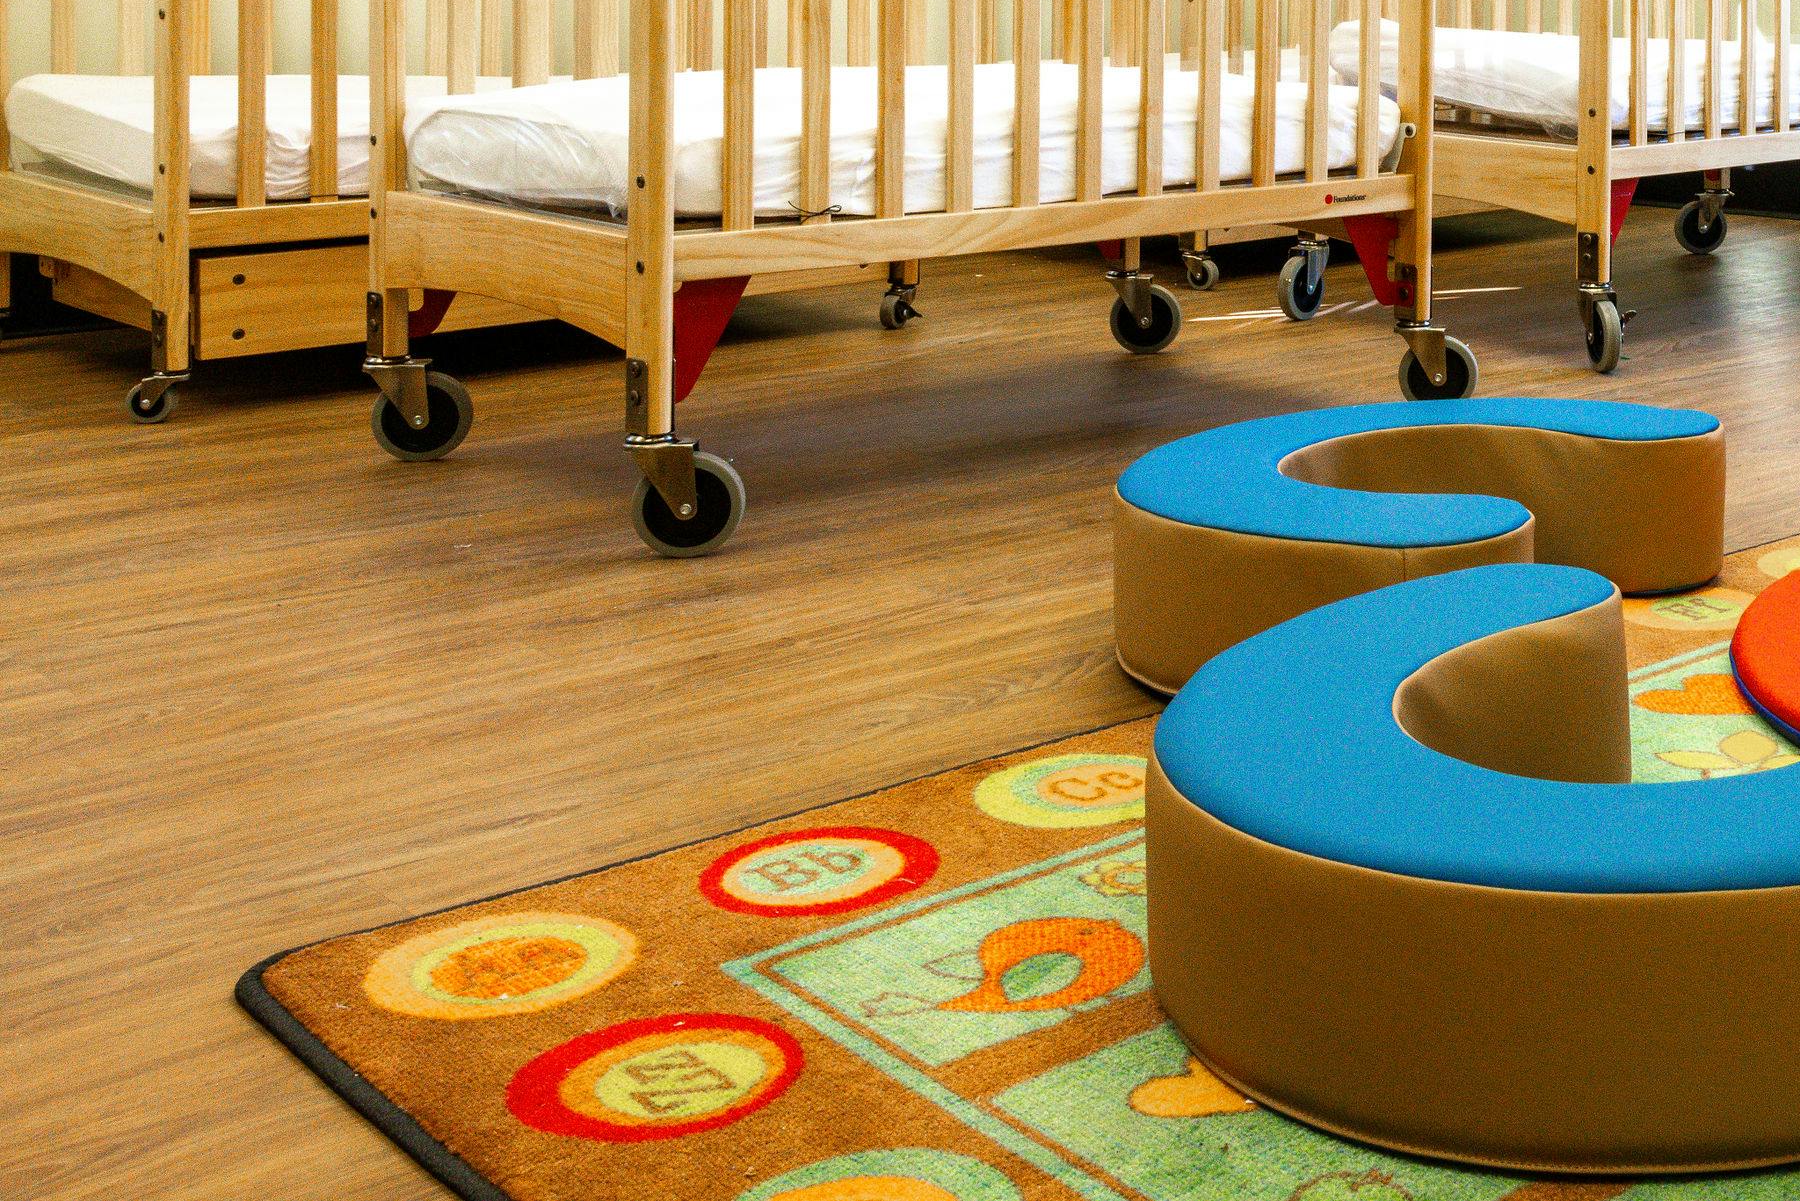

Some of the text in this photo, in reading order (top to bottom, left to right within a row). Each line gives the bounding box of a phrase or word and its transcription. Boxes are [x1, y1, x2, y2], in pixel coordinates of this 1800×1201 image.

[1333, 194, 1365, 203] Foundations
[1048, 767, 1143, 802] Cc
[742, 851, 862, 892] Bb
[625, 1050, 738, 1114] Zz
